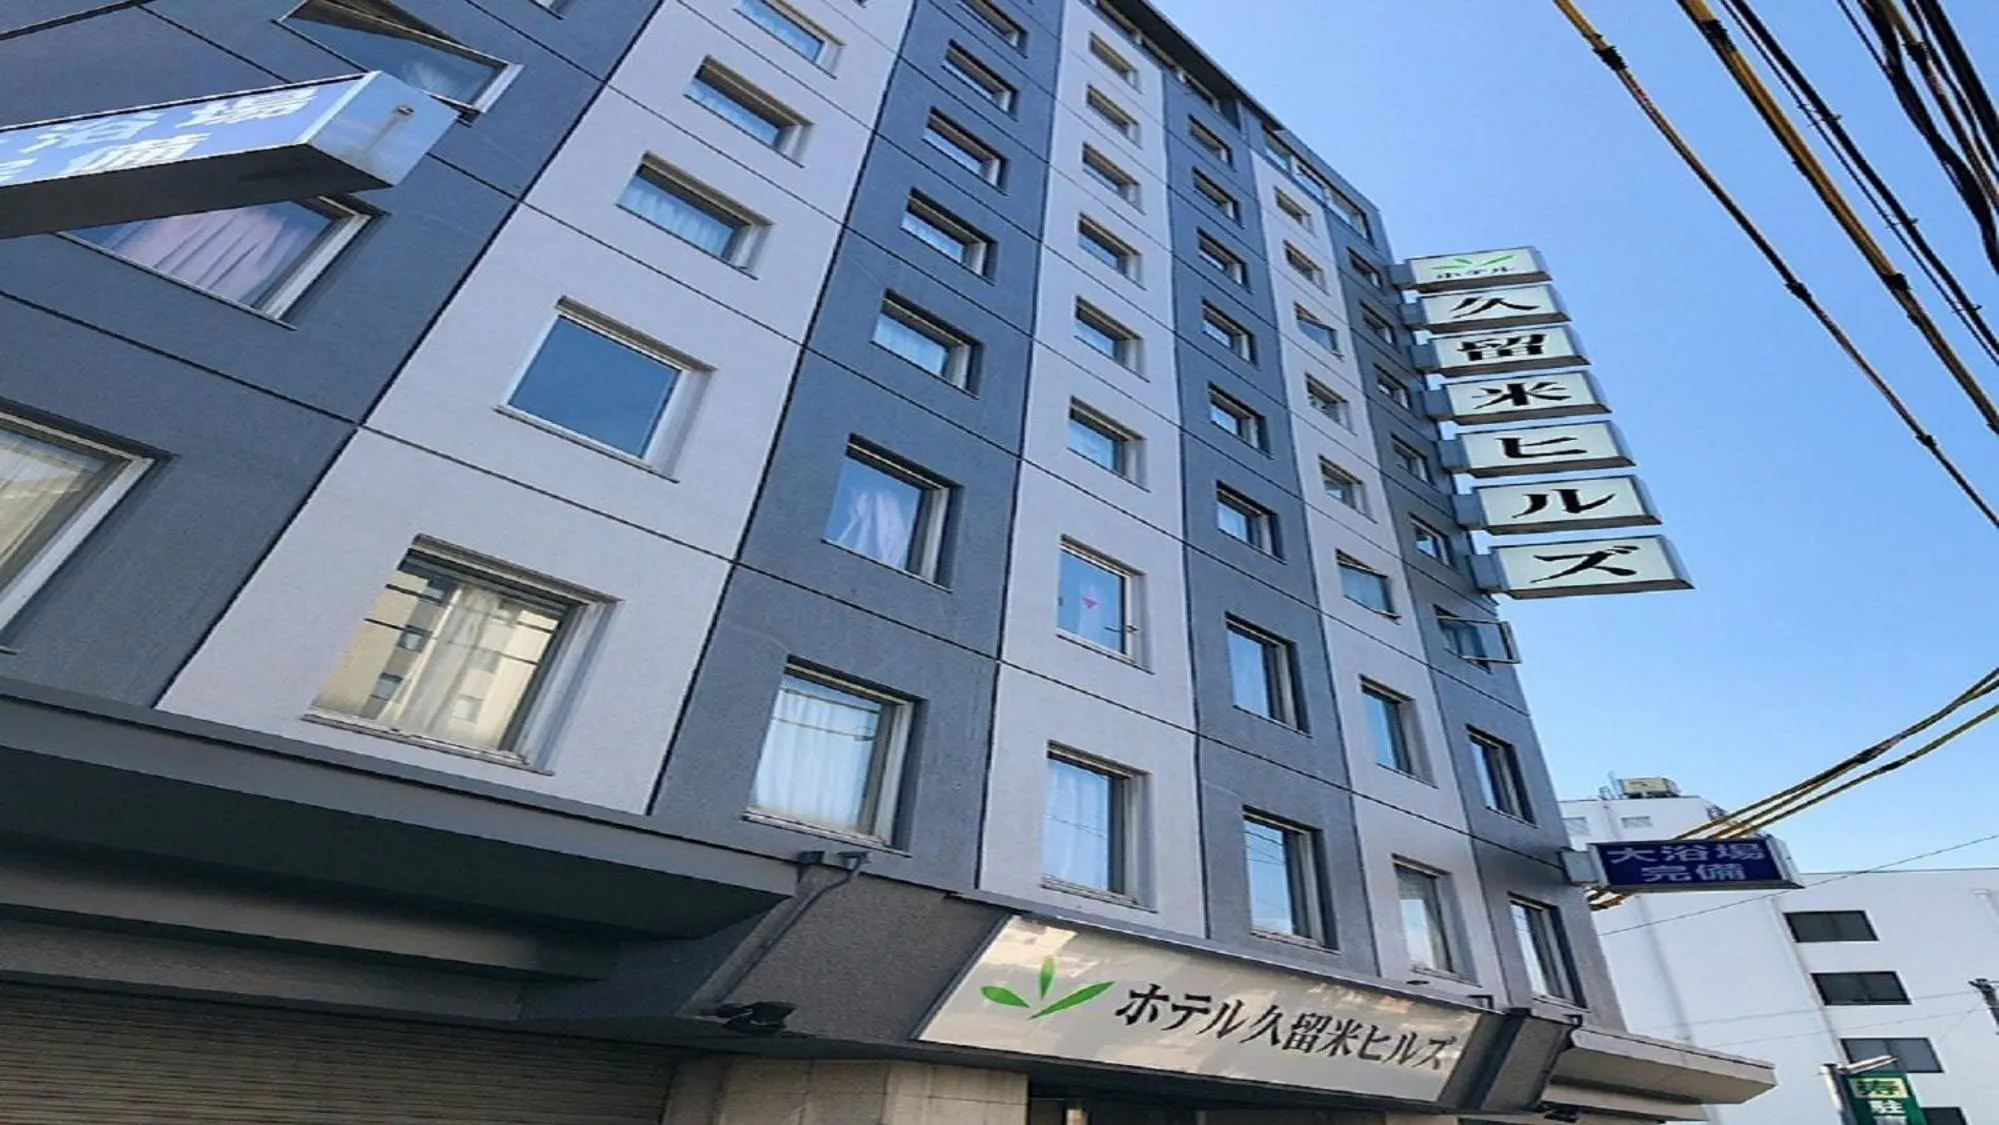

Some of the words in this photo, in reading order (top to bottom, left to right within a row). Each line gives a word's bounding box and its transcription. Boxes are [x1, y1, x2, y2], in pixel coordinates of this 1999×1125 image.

[1449, 296, 1640, 584] 久留米ヒルズ
[1606, 843, 1767, 863] 大浴場
[1640, 863, 1746, 883] 完備
